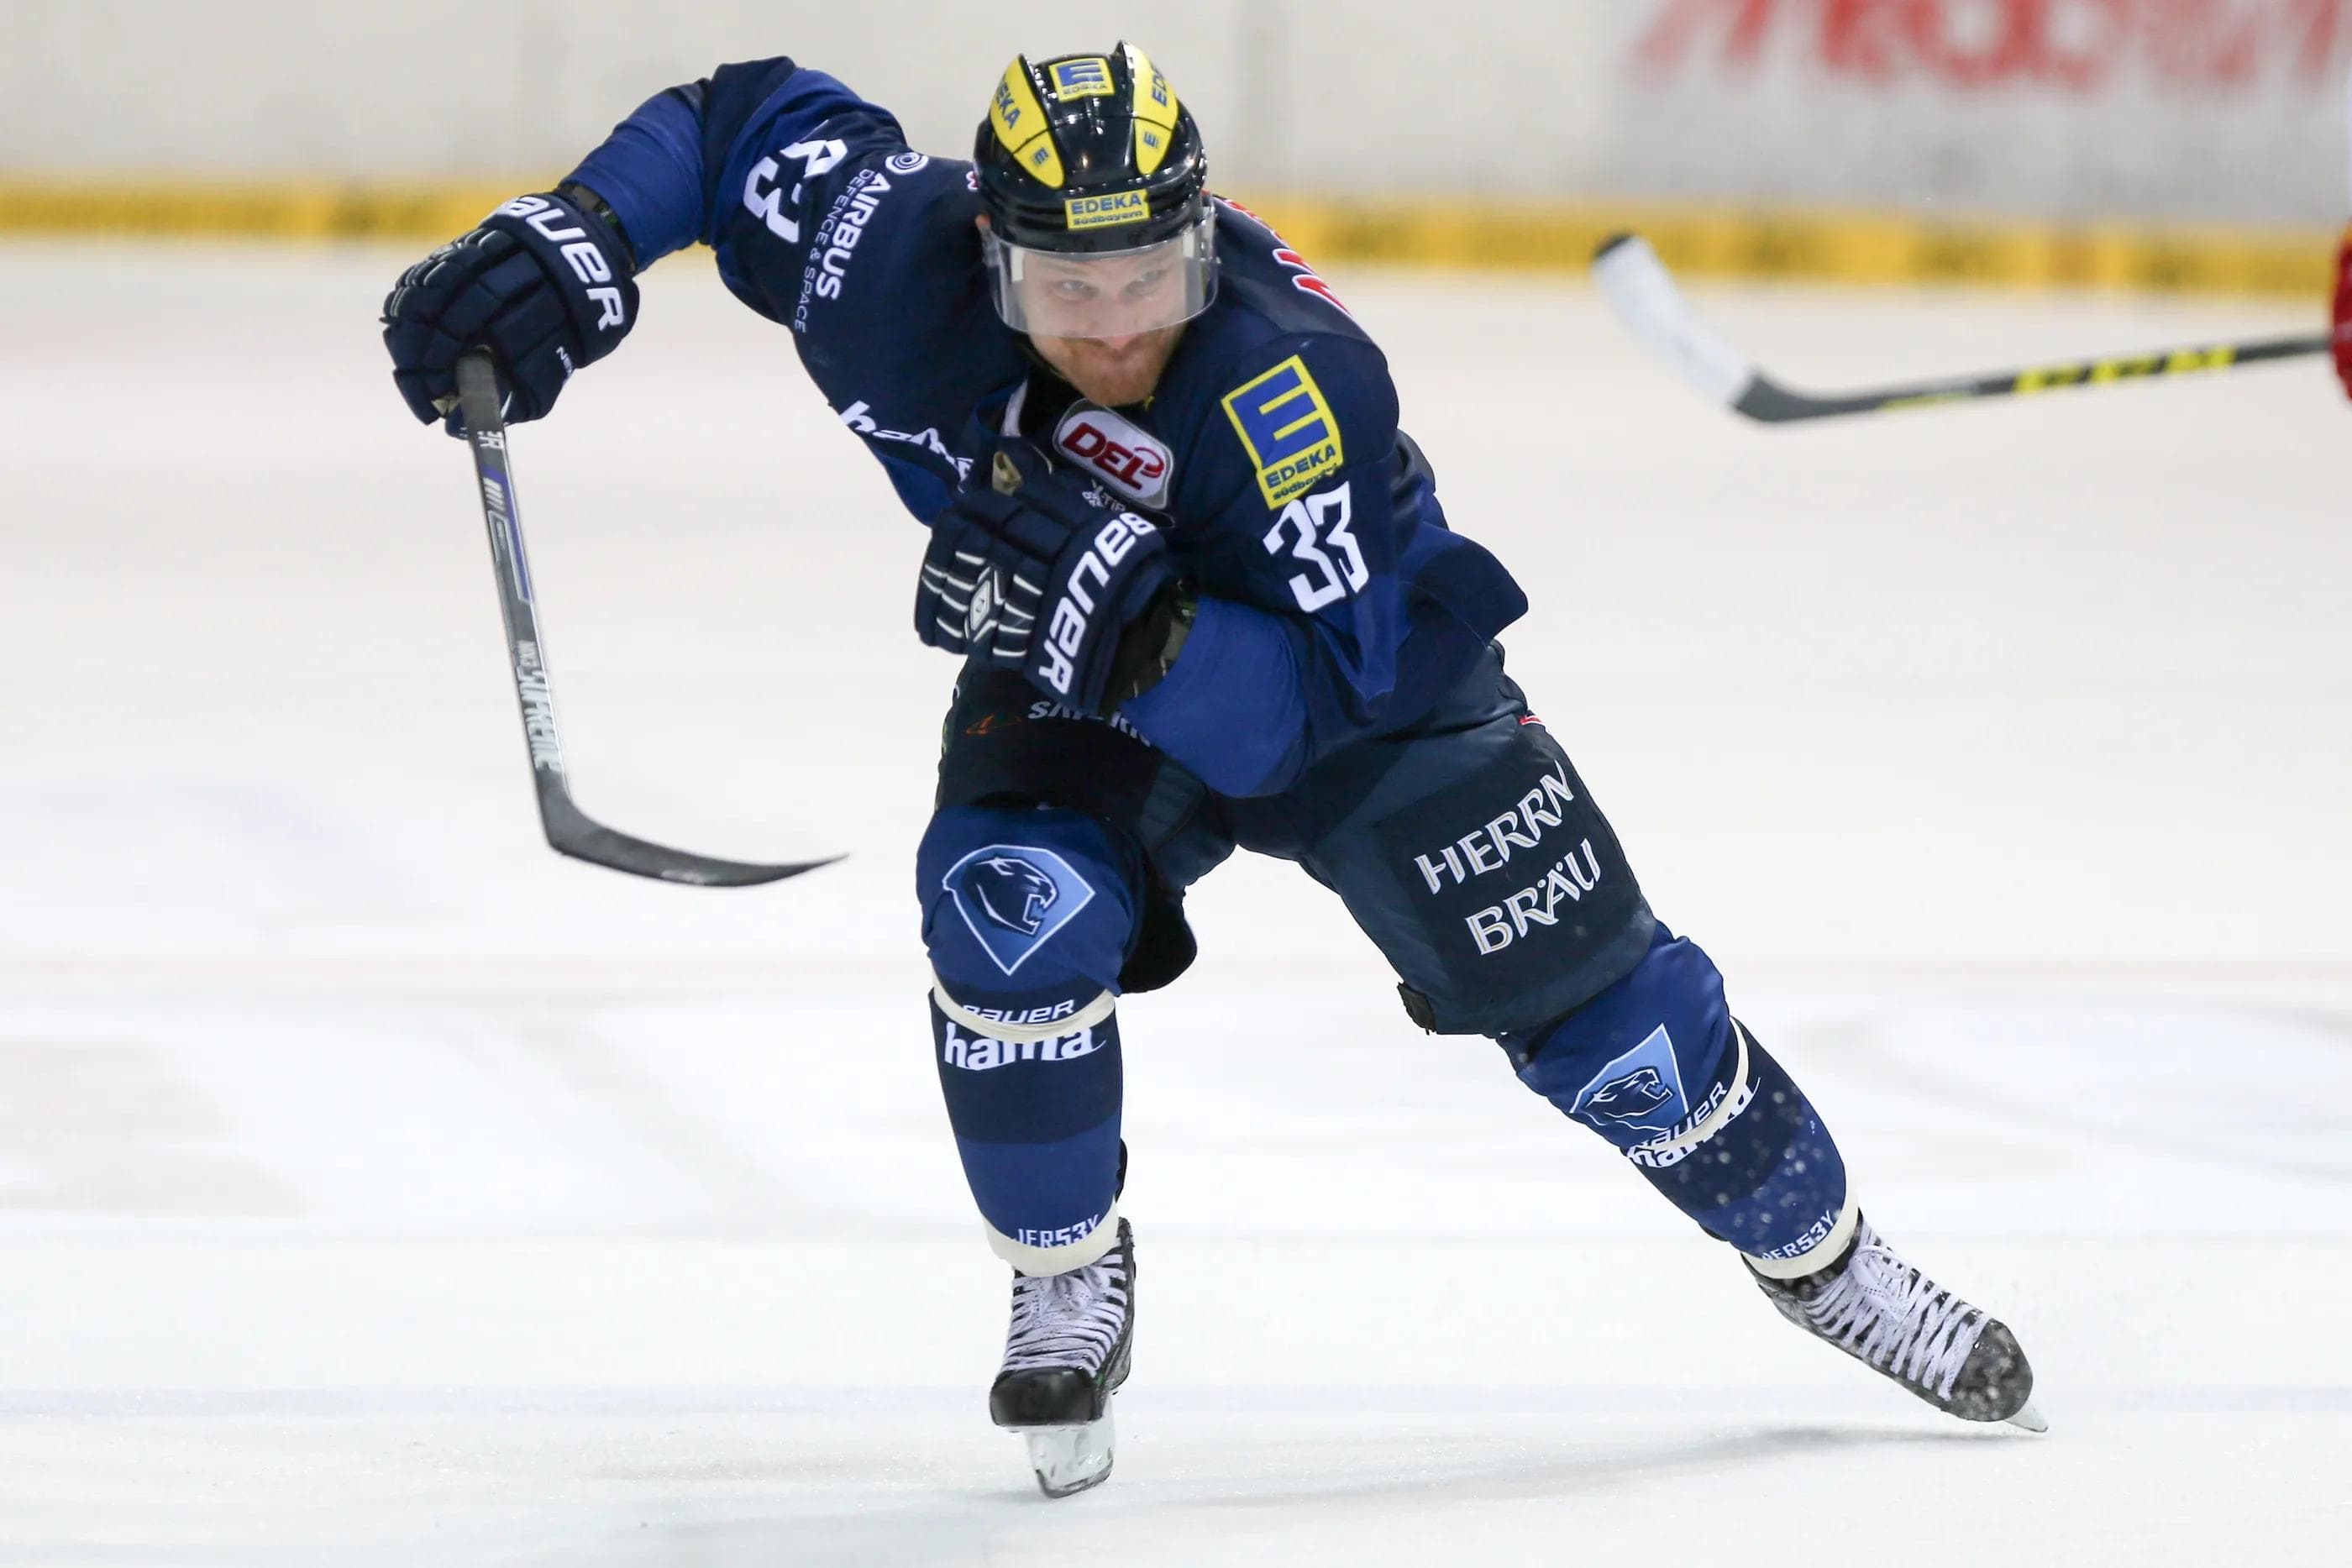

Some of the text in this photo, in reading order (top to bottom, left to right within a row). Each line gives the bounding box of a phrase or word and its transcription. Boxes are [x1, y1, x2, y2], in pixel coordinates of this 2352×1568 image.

[1058, 60, 1104, 87] E
[795, 168, 875, 333] DEFENCE & SPACE
[816, 172, 891, 301] AIRBUS
[1071, 192, 1142, 214] EDEKA
[1062, 422, 1165, 490] DEL
[1230, 365, 1330, 469] E
[1265, 443, 1336, 489] EDEKA
[1038, 511, 1158, 695] BAUER
[1263, 480, 1369, 613] 33
[1415, 759, 1574, 894] HERRN
[1465, 838, 1601, 956] BRÄU
